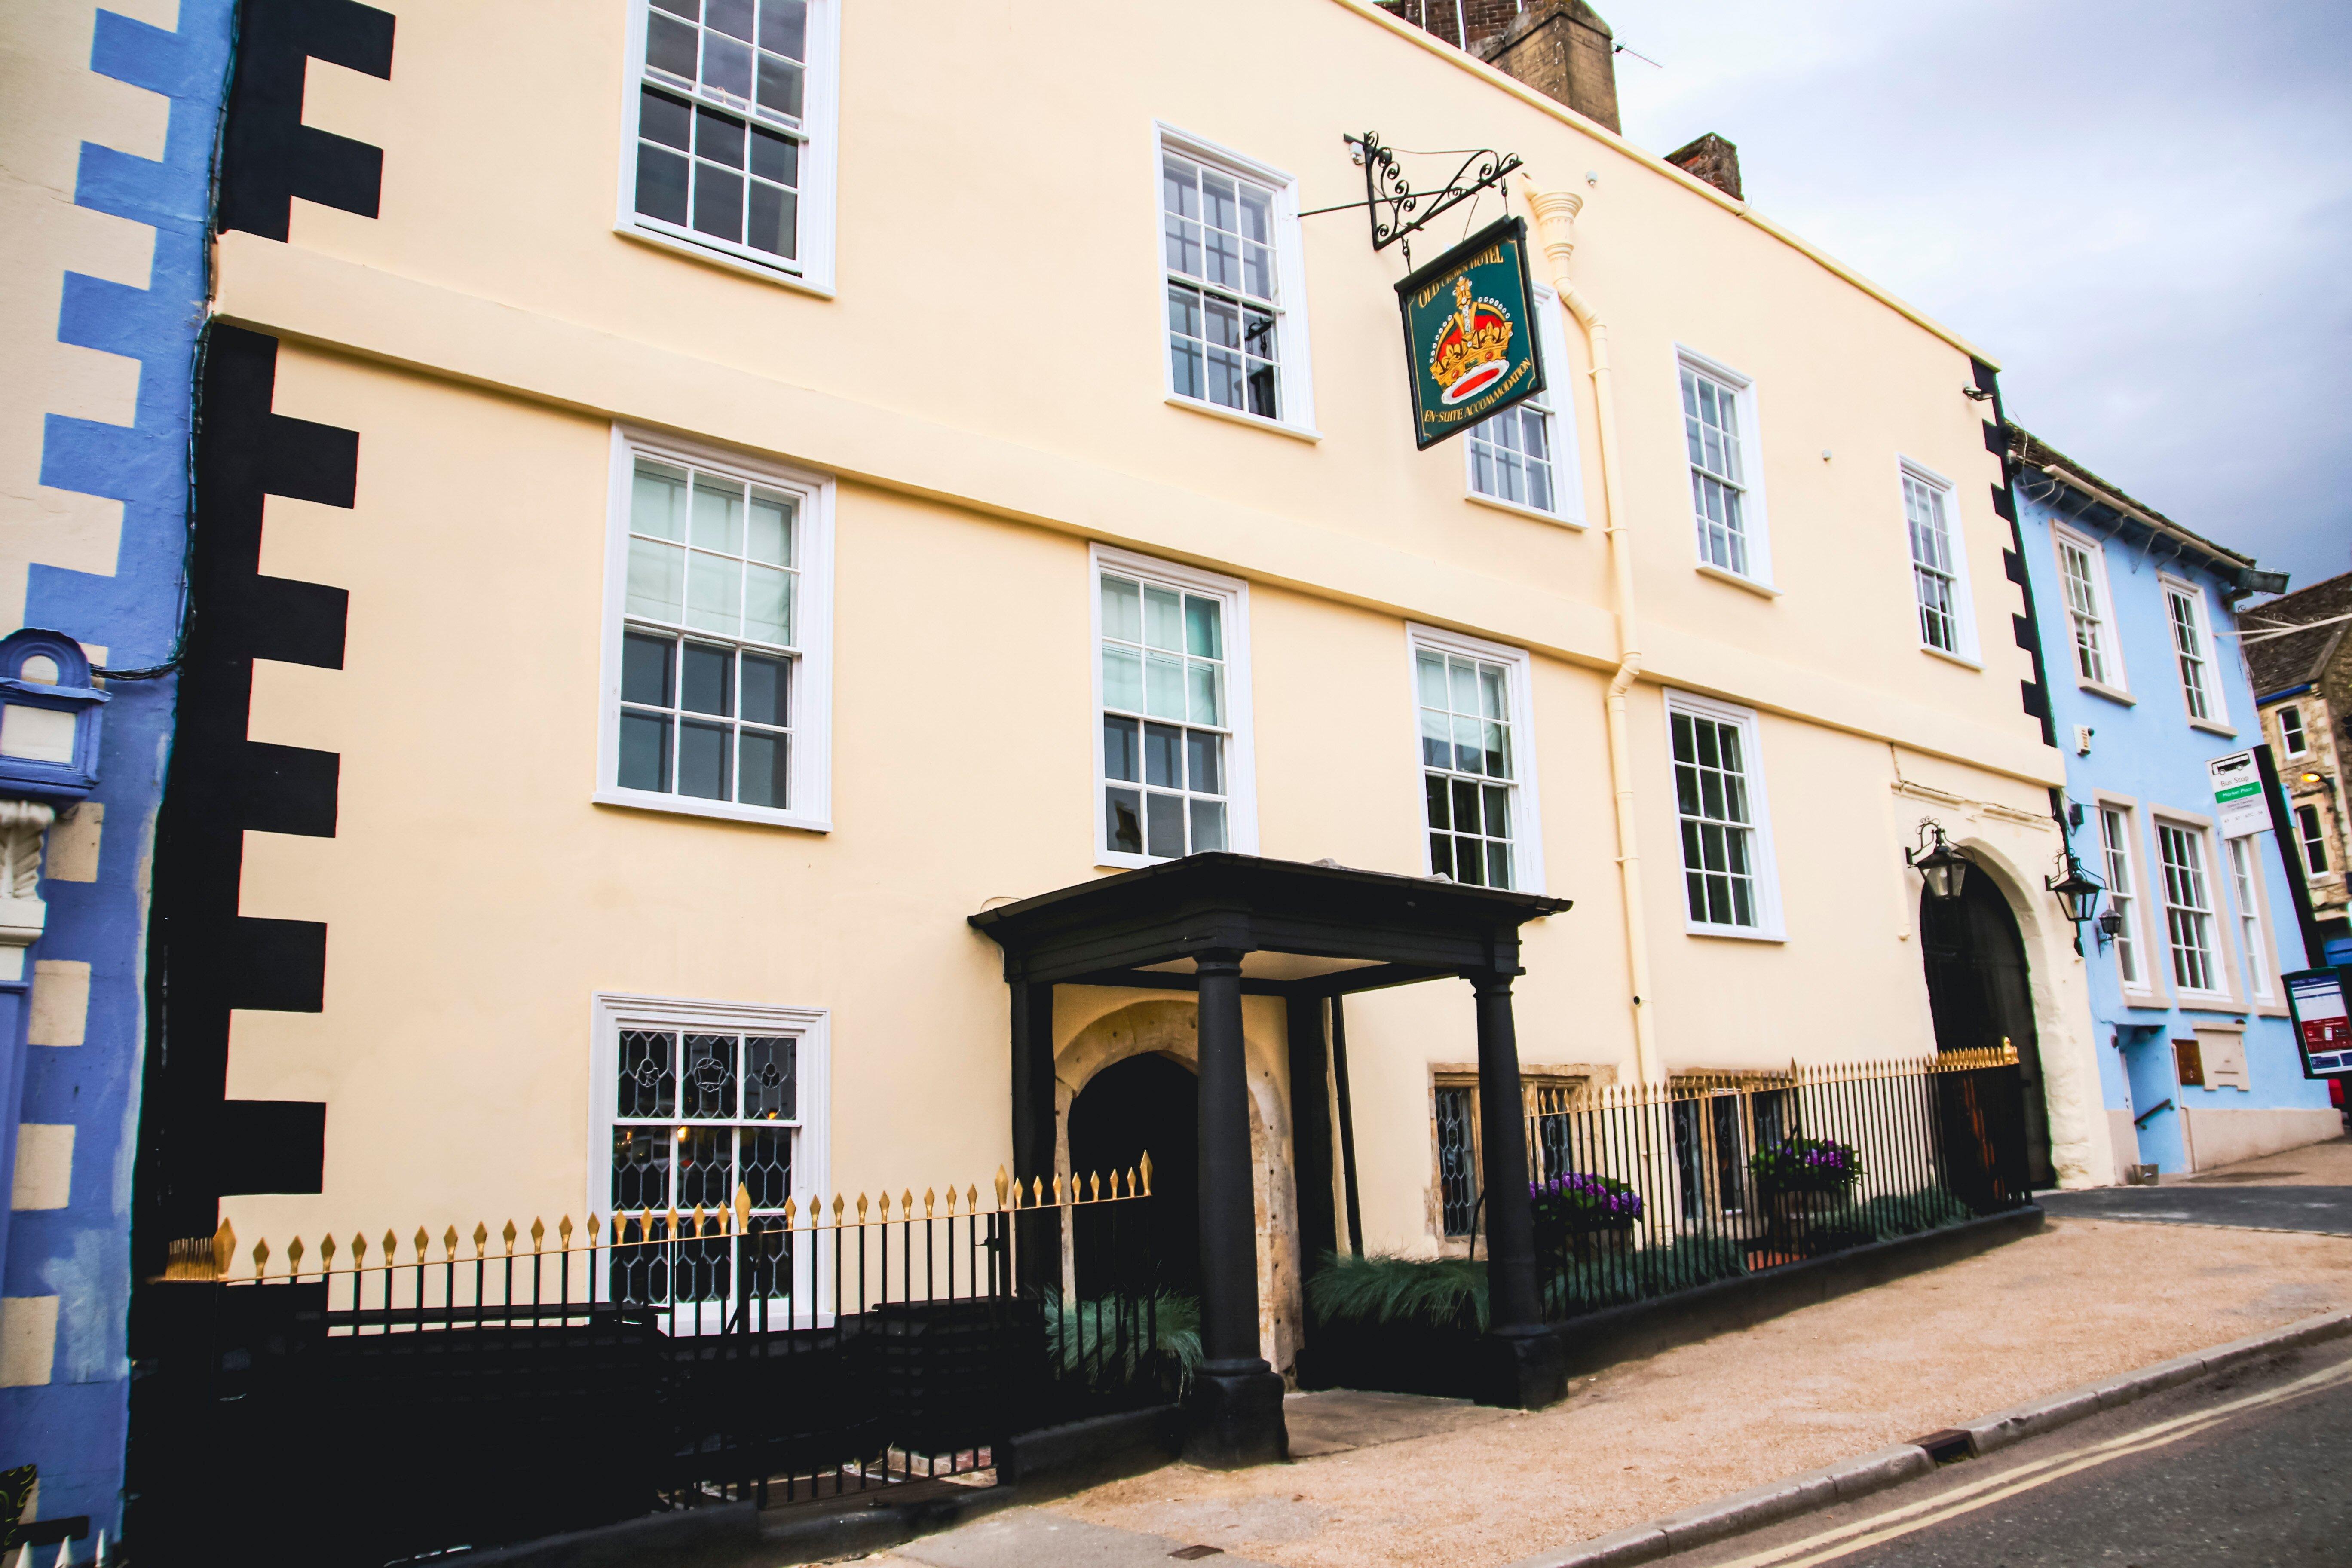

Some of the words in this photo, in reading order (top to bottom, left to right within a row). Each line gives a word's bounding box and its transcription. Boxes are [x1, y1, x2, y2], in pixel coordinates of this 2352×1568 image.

[1419, 282, 1439, 308] OLD
[1441, 263, 1468, 287] CROWN
[1470, 245, 1504, 270] HOTEL
[1424, 408, 1463, 423] EN-SUITE
[1464, 357, 1531, 418] ACCOMMODATION
